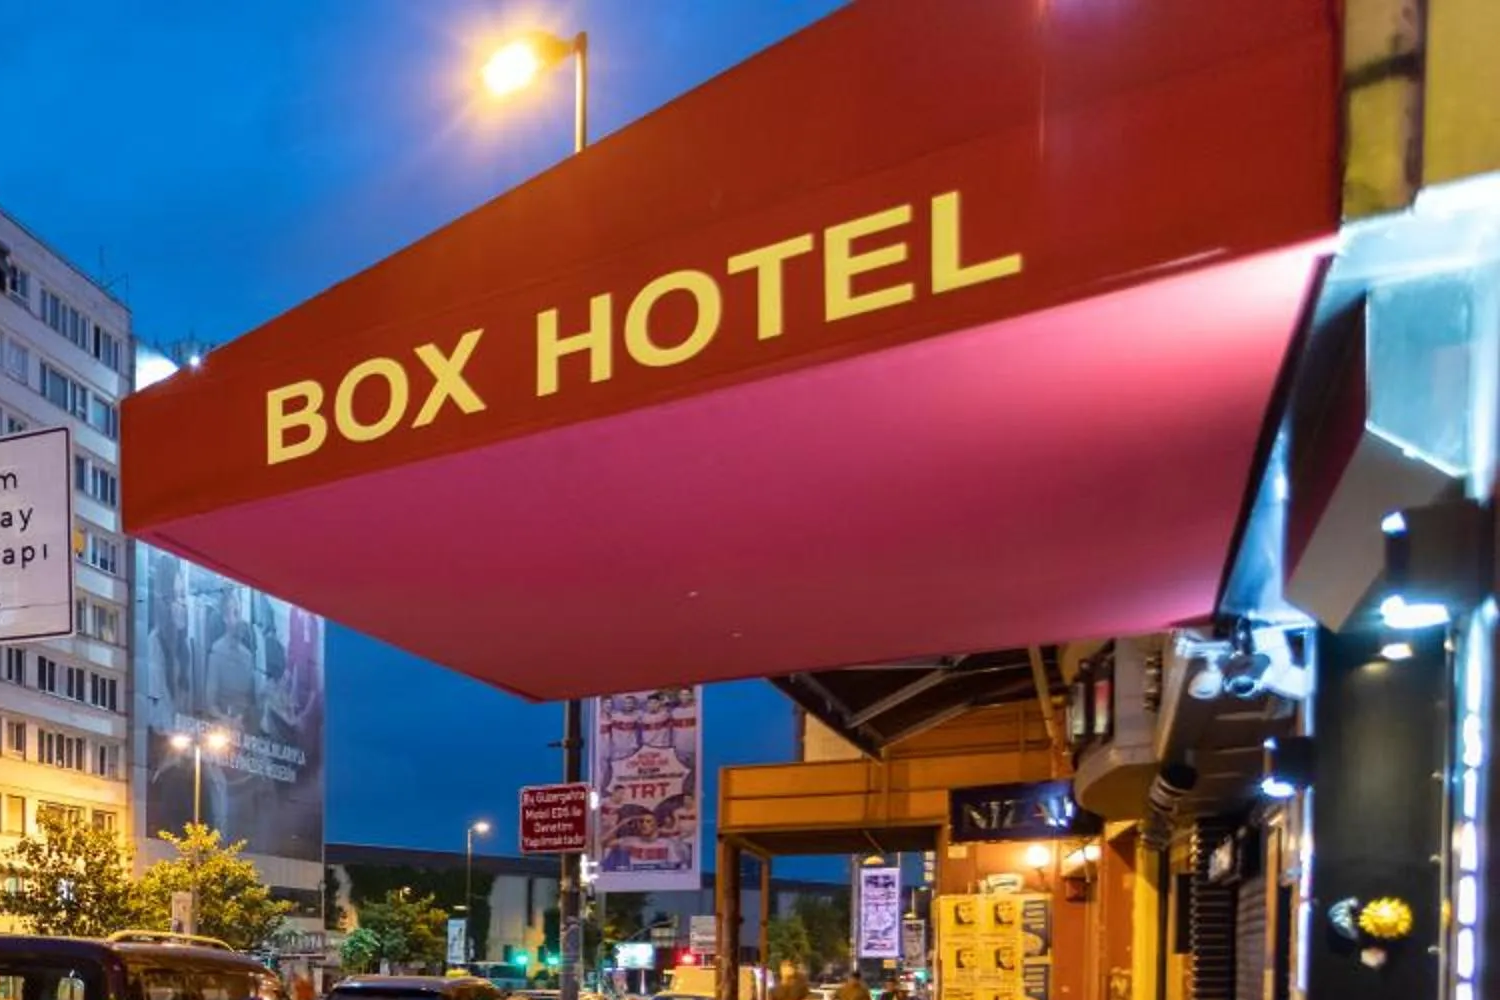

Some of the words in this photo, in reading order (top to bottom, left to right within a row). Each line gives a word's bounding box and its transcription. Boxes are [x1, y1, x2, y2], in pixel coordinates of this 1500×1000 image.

[266, 327, 488, 465] BOX
[536, 190, 1023, 398] HOTEL
[627, 782, 671, 799] TRT
